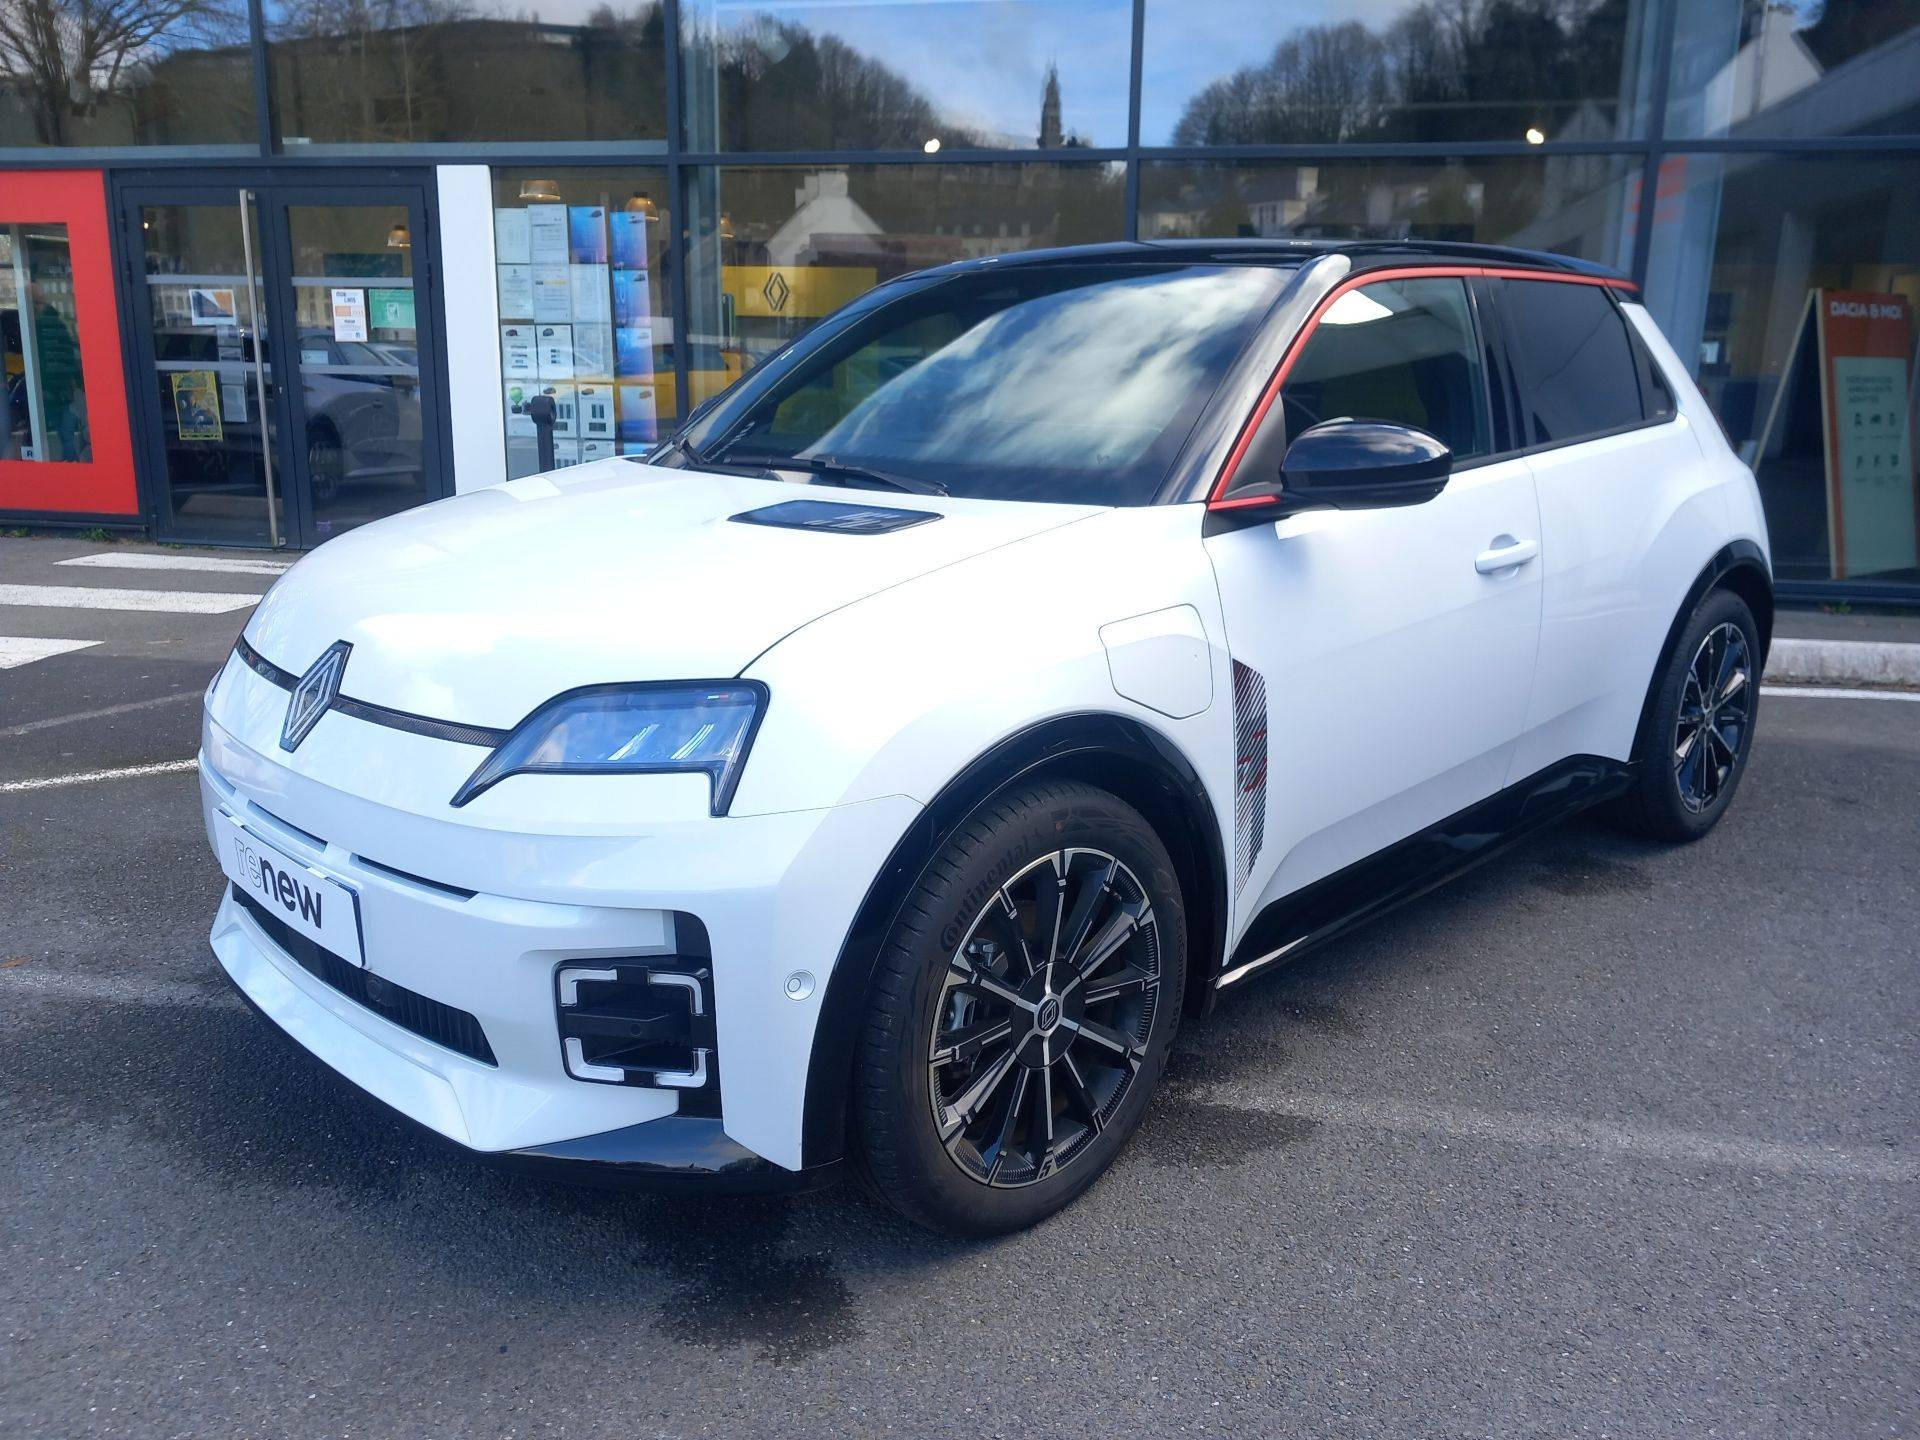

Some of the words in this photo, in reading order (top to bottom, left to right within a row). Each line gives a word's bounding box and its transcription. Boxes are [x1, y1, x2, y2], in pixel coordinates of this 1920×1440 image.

[1830, 301, 1868, 318] DACIA
[234, 836, 322, 929] renew
[941, 839, 1031, 951] Continental
